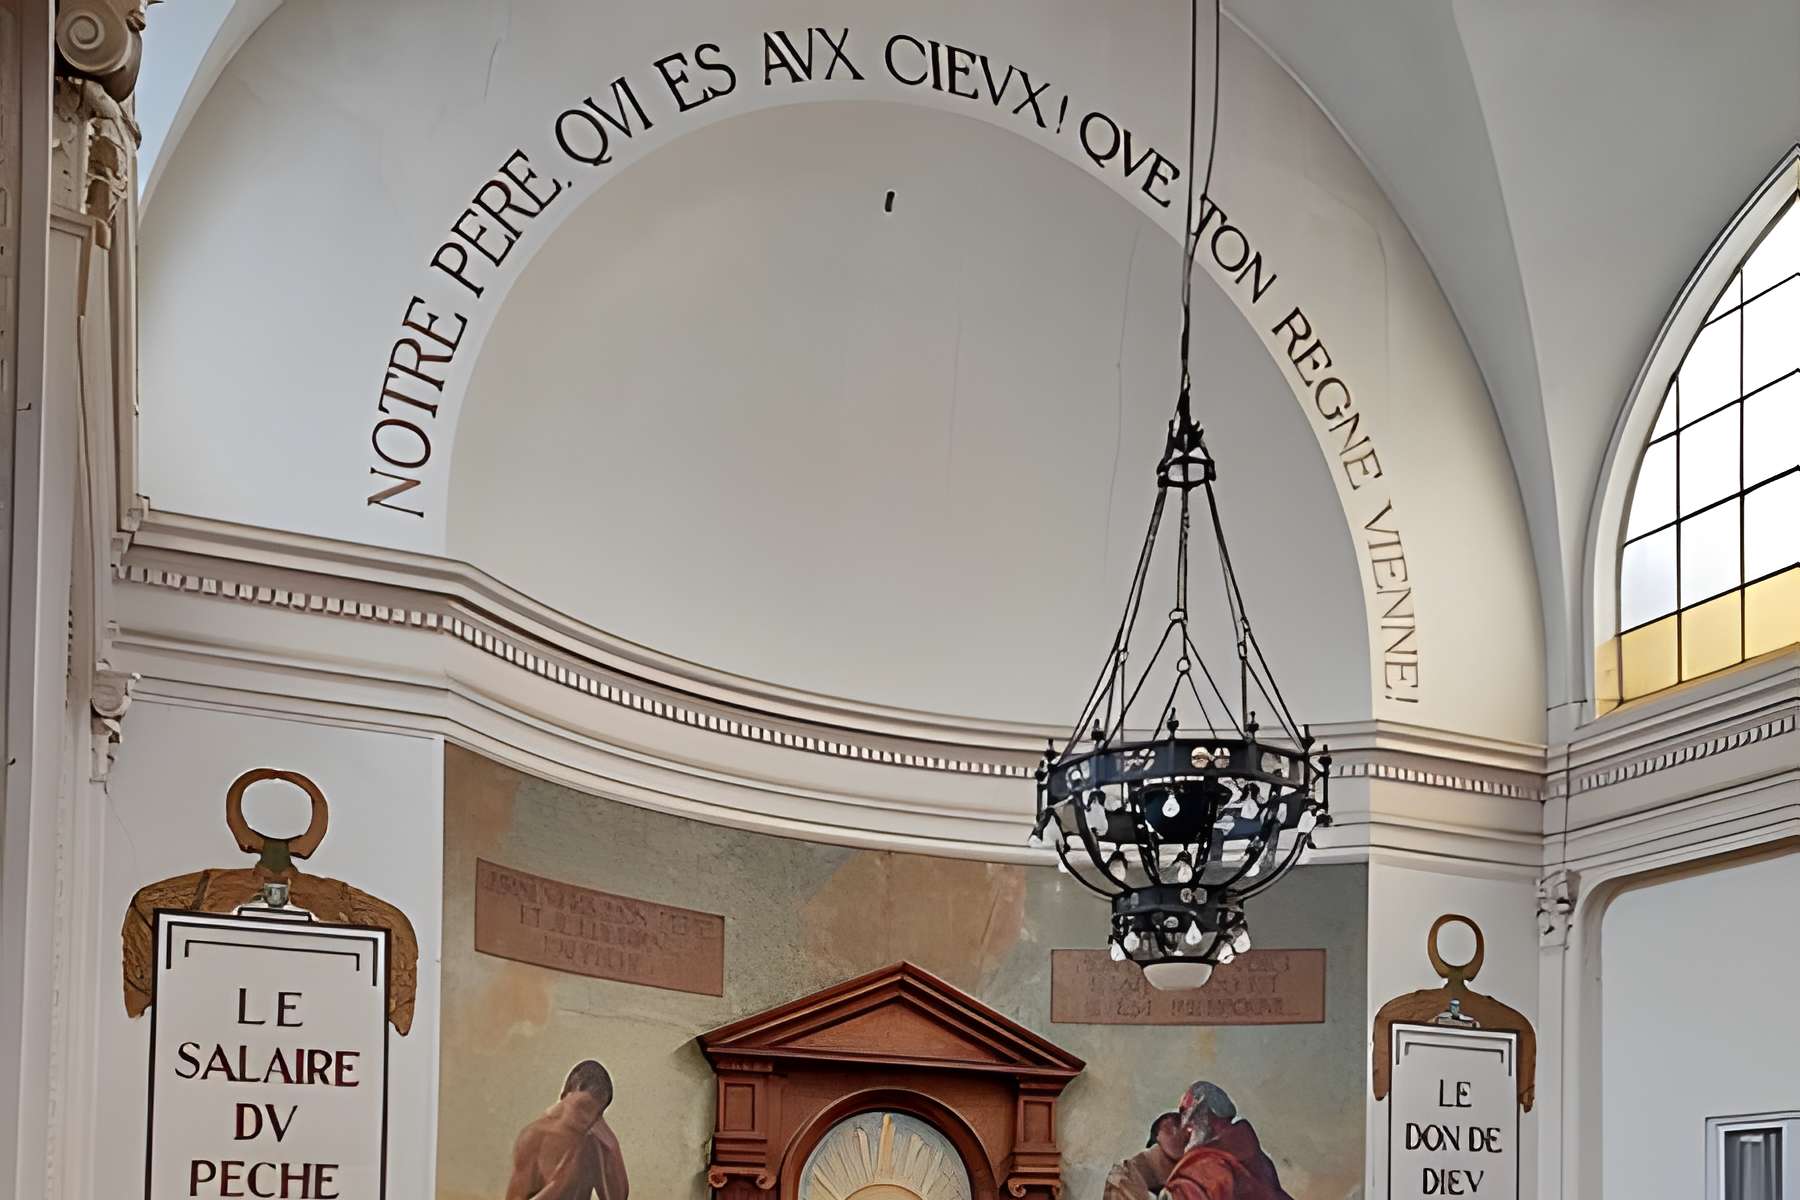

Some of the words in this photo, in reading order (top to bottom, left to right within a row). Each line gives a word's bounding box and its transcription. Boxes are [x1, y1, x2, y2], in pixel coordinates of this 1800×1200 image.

[367, 296, 468, 519] NOTRE
[554, 77, 655, 168] QVI
[653, 43, 737, 113] ES
[763, 27, 866, 87] AVX
[1079, 111, 1181, 209] QVE
[1191, 194, 1278, 305] TON
[1271, 305, 1384, 492] REGNE
[237, 987, 304, 1028] LE
[174, 1041, 361, 1087] SALAIRE
[1438, 1078, 1473, 1109] LE
[234, 1102, 299, 1143] DV
[1405, 1122, 1461, 1152] DON
[1468, 1126, 1503, 1154] DE
[190, 1160, 340, 1200] PECHE
[1422, 1167, 1485, 1197] DIEV
